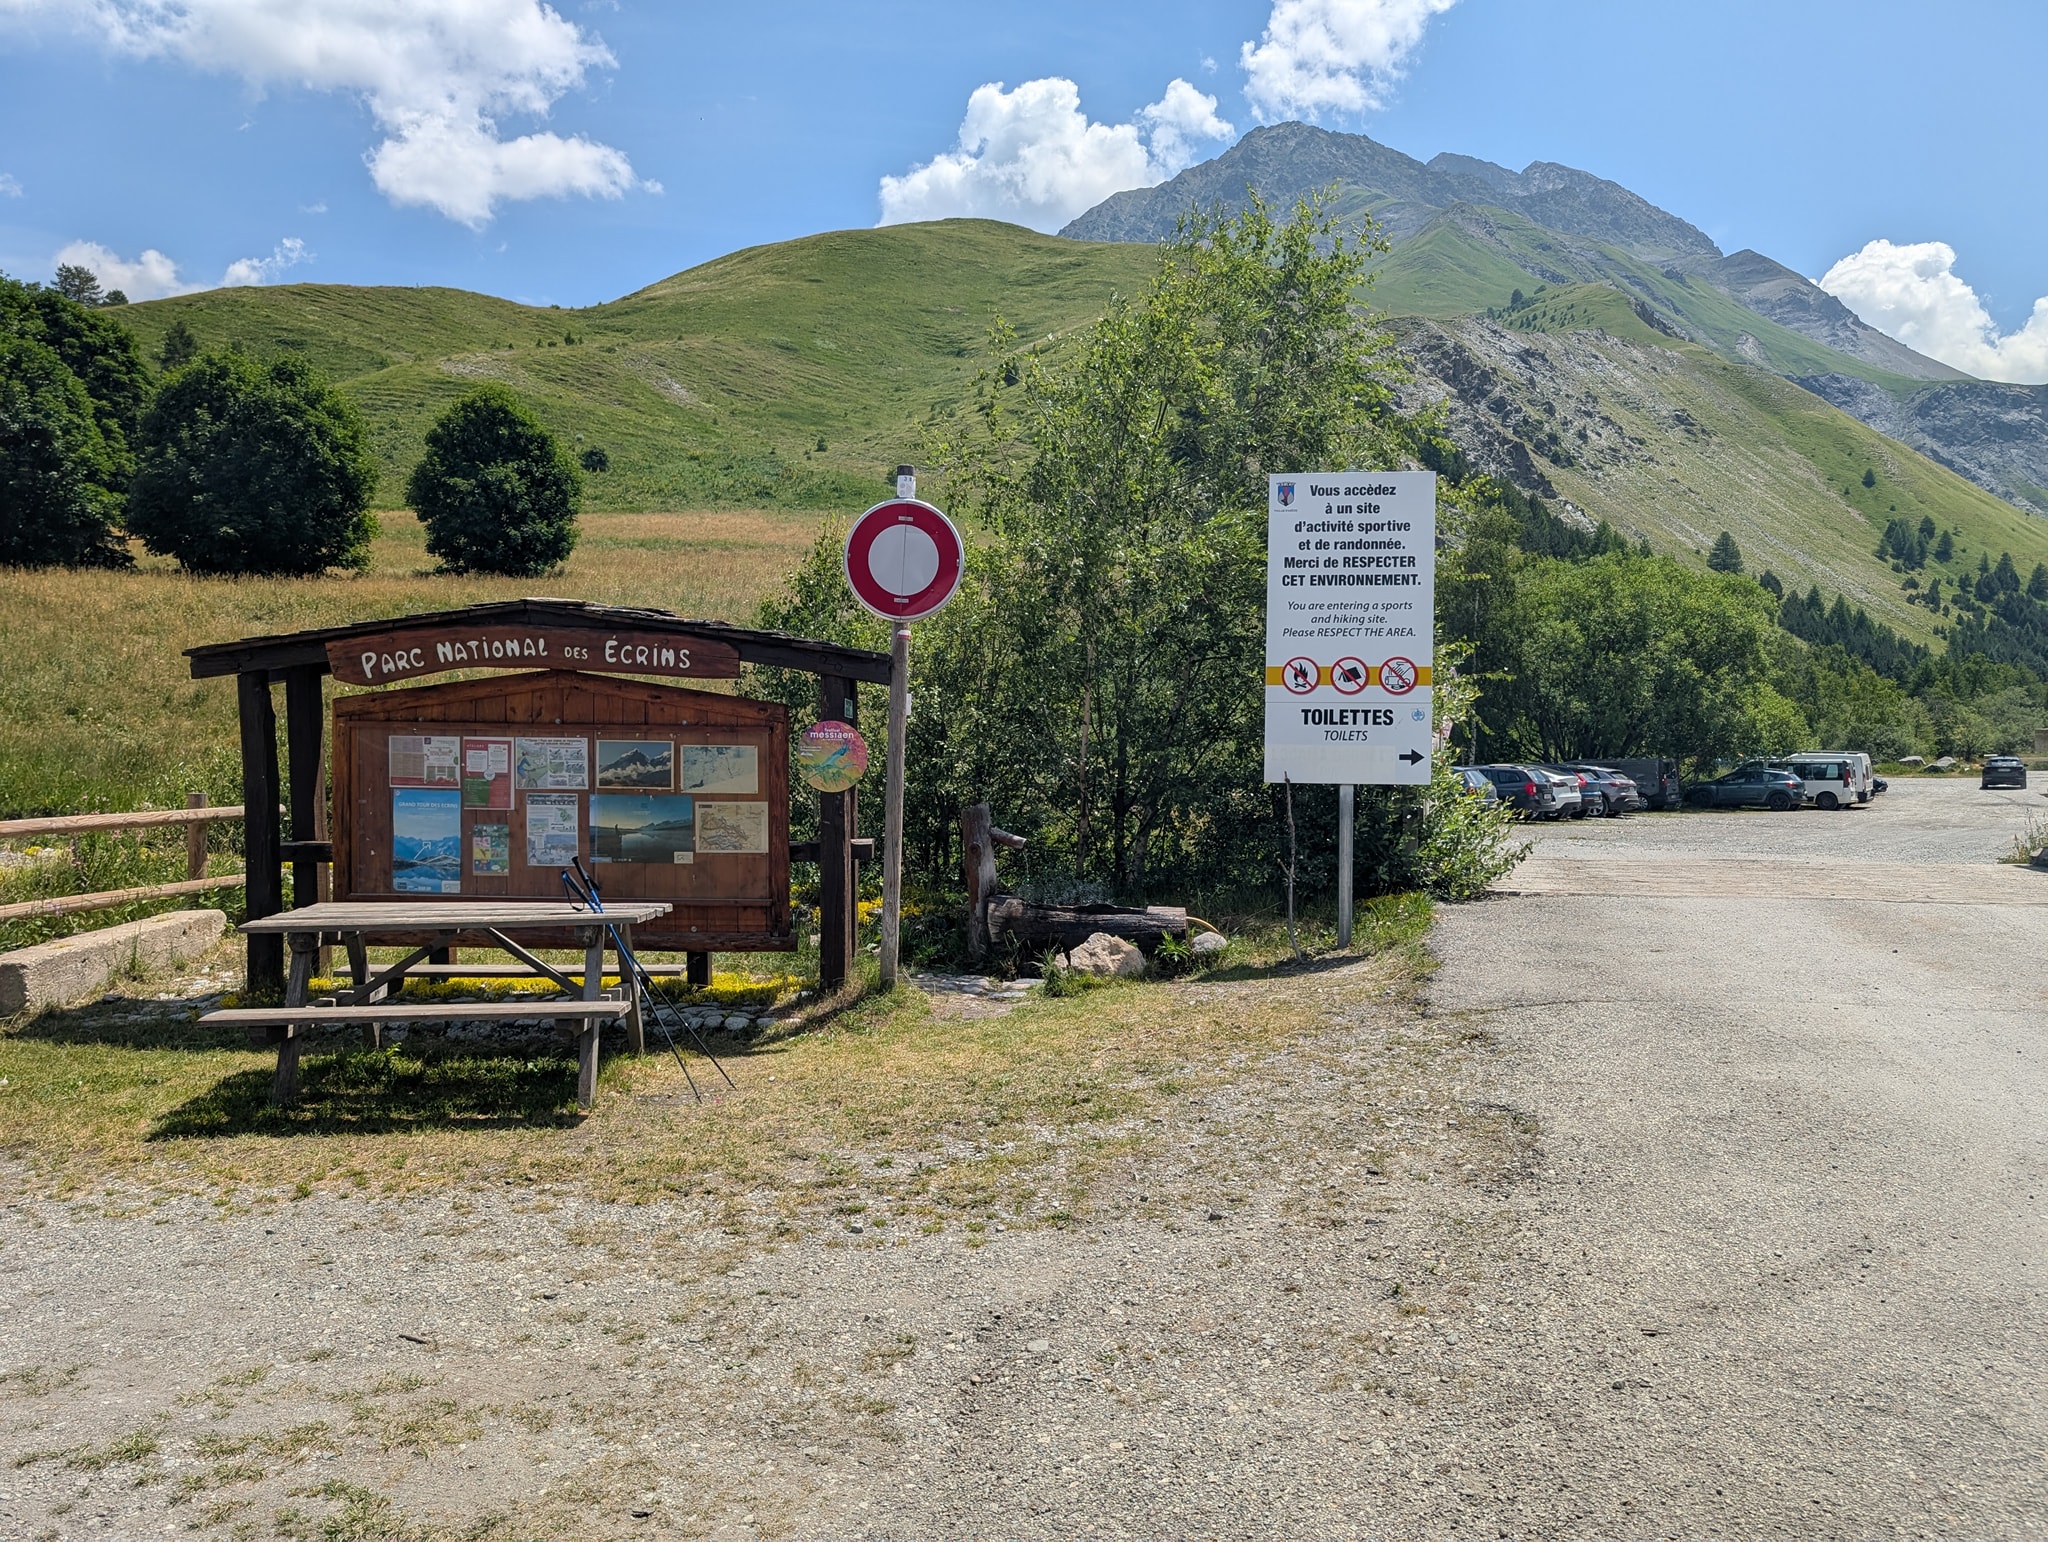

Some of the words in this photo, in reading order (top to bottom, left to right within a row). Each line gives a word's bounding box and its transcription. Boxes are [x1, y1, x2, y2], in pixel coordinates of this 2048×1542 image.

[1310, 485, 1340, 496] Vous
[1344, 484, 1396, 496] accèdez
[1325, 502, 1332, 514] à
[1336, 504, 1352, 514] un
[1357, 502, 1380, 514] site
[1358, 519, 1411, 534] sportive
[1299, 539, 1311, 550] et
[1315, 539, 1330, 550] de
[1334, 538, 1405, 550] randonnée.
[1284, 556, 1319, 568] Merci
[1323, 556, 1339, 568] de
[1343, 556, 1416, 568] RESPECTER
[1282, 575, 1305, 586] CET
[1310, 574, 1421, 586] ENVIRONNEMENT.
[1288, 601, 1305, 611] You
[1307, 602, 1324, 611] are
[1326, 600, 1369, 613] entering
[1372, 602, 1379, 610] a
[1381, 601, 1413, 613] sports
[1311, 614, 1332, 624] and
[1333, 614, 1365, 626] hiking
[1367, 614, 1388, 624] site.
[1283, 627, 1315, 637] Please
[1317, 628, 1362, 637] RESPECT
[1364, 627, 1385, 637] THE
[1386, 627, 1416, 637] AREA.
[361, 648, 425, 679] PARC
[437, 636, 548, 663] NATIONAL
[564, 646, 588, 660] DES
[605, 635, 691, 668] ÉCRINS
[1301, 709, 1393, 725] TOILETTES
[1324, 730, 1368, 741] TOILETS
